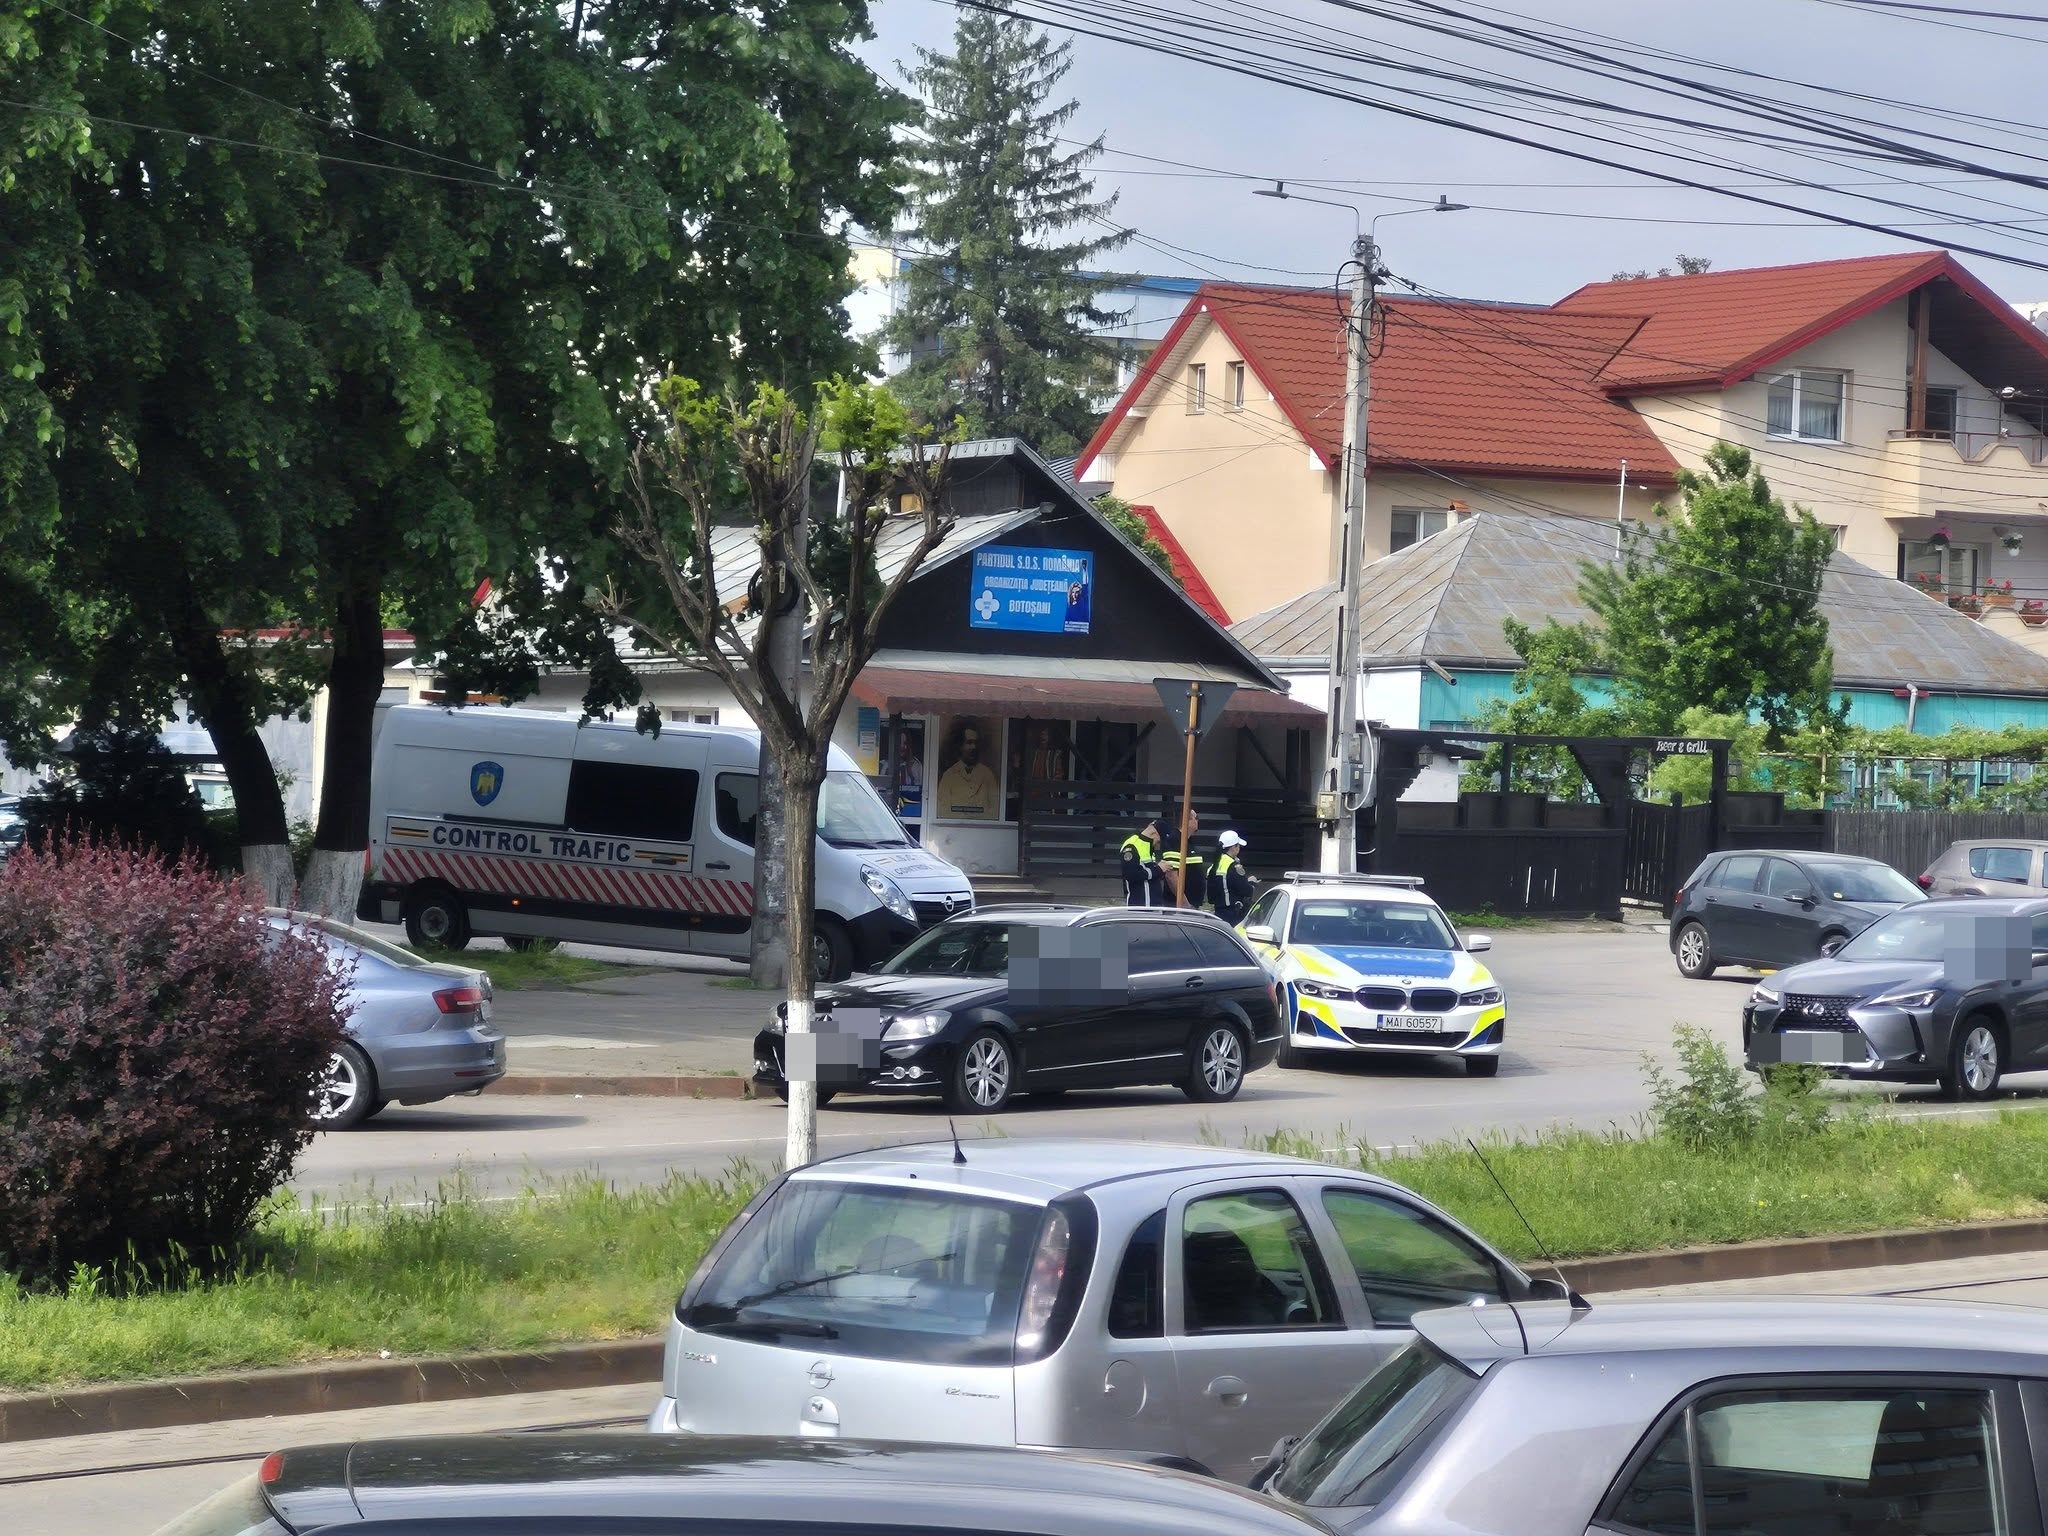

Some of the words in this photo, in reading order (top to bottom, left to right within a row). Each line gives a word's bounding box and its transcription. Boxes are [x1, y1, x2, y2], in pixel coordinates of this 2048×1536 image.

[977, 553, 1015, 568] PARTIDUL
[1017, 556, 1040, 570] S.O.S.
[1009, 600, 1050, 617] BOTOȘANI
[433, 826, 542, 854] CONTROL
[549, 836, 630, 862] TRAFIC
[1386, 1017, 1402, 1027] MAI
[1406, 1018, 1438, 1029] 60557
